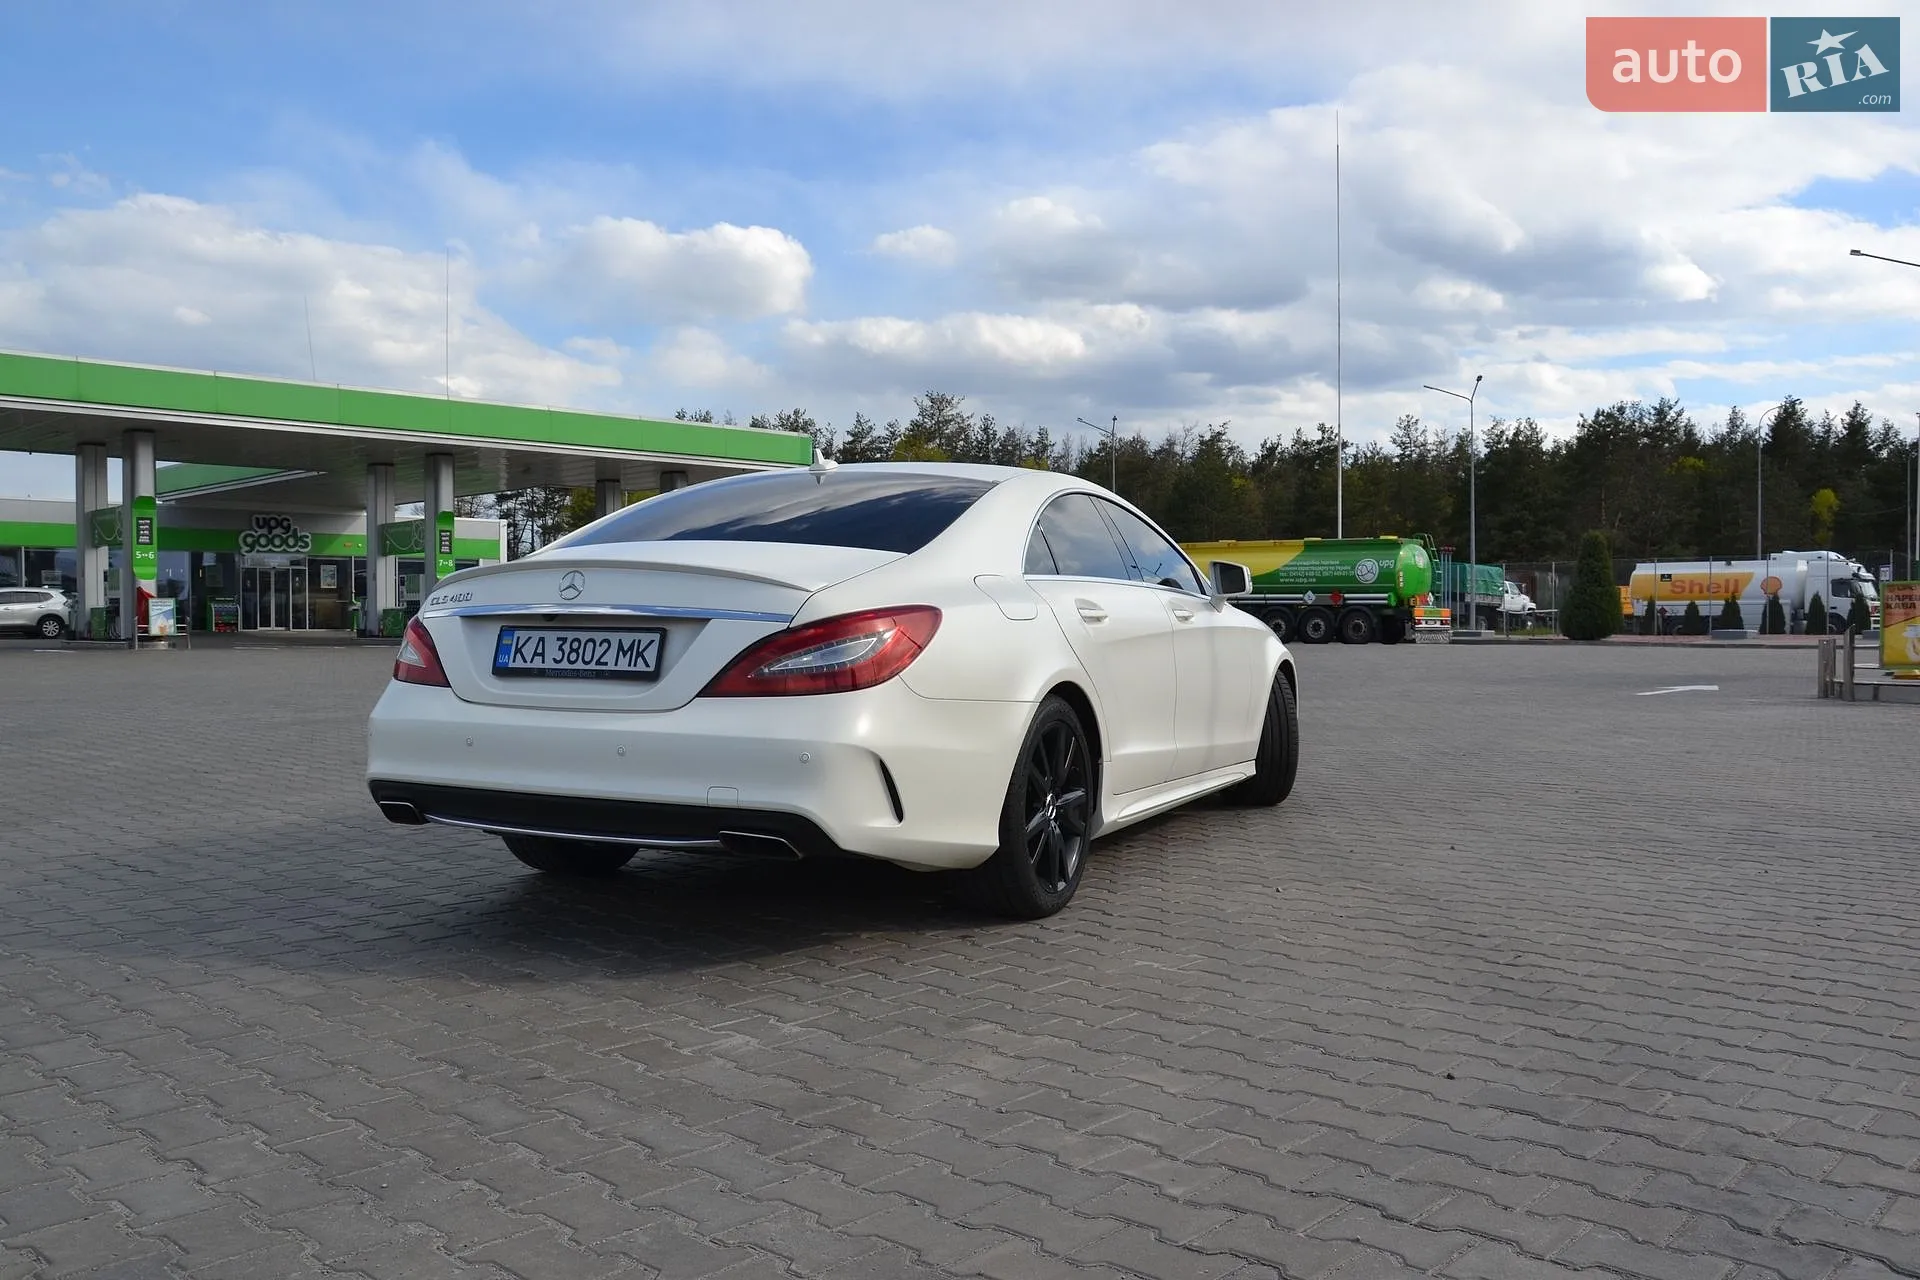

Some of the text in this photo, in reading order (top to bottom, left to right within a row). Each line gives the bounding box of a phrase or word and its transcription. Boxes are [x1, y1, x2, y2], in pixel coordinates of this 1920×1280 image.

[253, 516, 292, 535] upg
[241, 527, 310, 554] goods
[1379, 559, 1395, 569] upg
[1670, 578, 1740, 594] Shell
[430, 591, 473, 606] CLS 400
[497, 653, 509, 663] UA
[511, 636, 656, 668] KA 3802 MK
